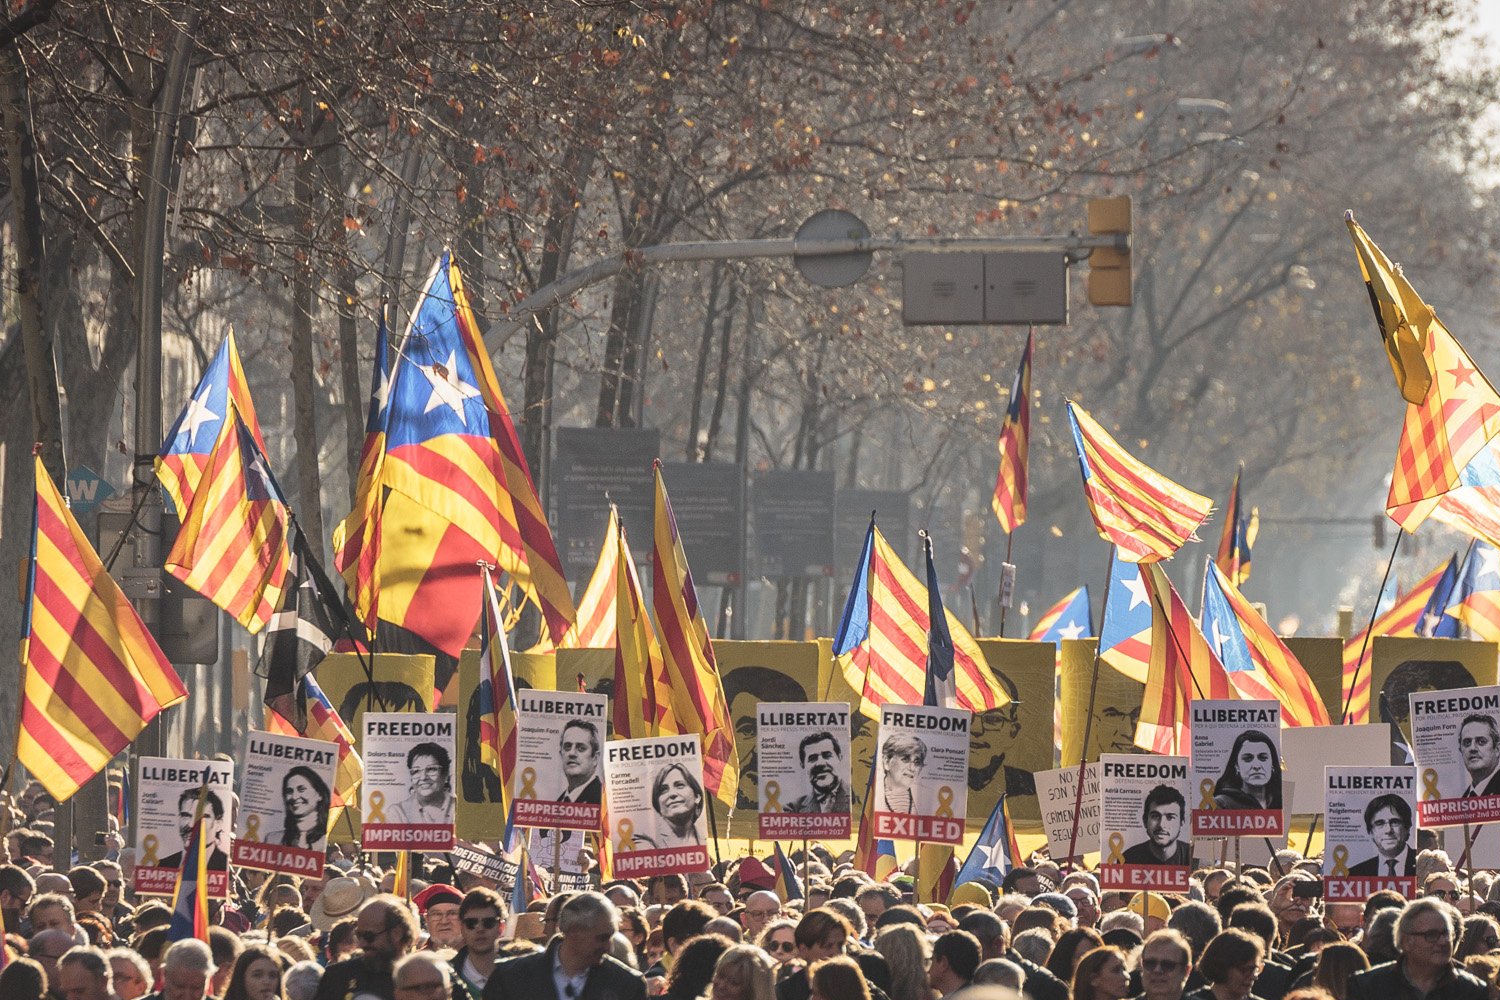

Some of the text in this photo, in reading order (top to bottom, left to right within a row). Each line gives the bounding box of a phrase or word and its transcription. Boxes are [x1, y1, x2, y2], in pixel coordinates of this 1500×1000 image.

[522, 699, 604, 717] LLIBERTAT
[1415, 695, 1499, 715] FREEDOM
[761, 713, 847, 725] LLIBERTAT
[883, 712, 967, 732] FREEDOM
[1194, 709, 1277, 722] LLIBERTAT
[368, 722, 451, 736] FREEDOM
[1416, 725, 1441, 733] Joaquim
[250, 740, 334, 765] LLIBERTAT
[609, 742, 695, 762] FREEDOM
[1059, 772, 1072, 784] NO
[1104, 763, 1186, 779] FREEDOM
[1329, 776, 1413, 789] LLIBERTAT
[516, 803, 599, 818] EMPRESONAT
[1442, 812, 1475, 821] November
[762, 817, 848, 827] EMPRESONAT
[878, 816, 960, 839] EXILED
[1198, 816, 1277, 829] EXILIADA
[365, 829, 451, 842] IMPRISONED
[238, 846, 317, 871] EXILIADA
[457, 859, 470, 869] NO
[616, 852, 705, 871] IMPRISONED
[1104, 868, 1187, 885] IN EXILE
